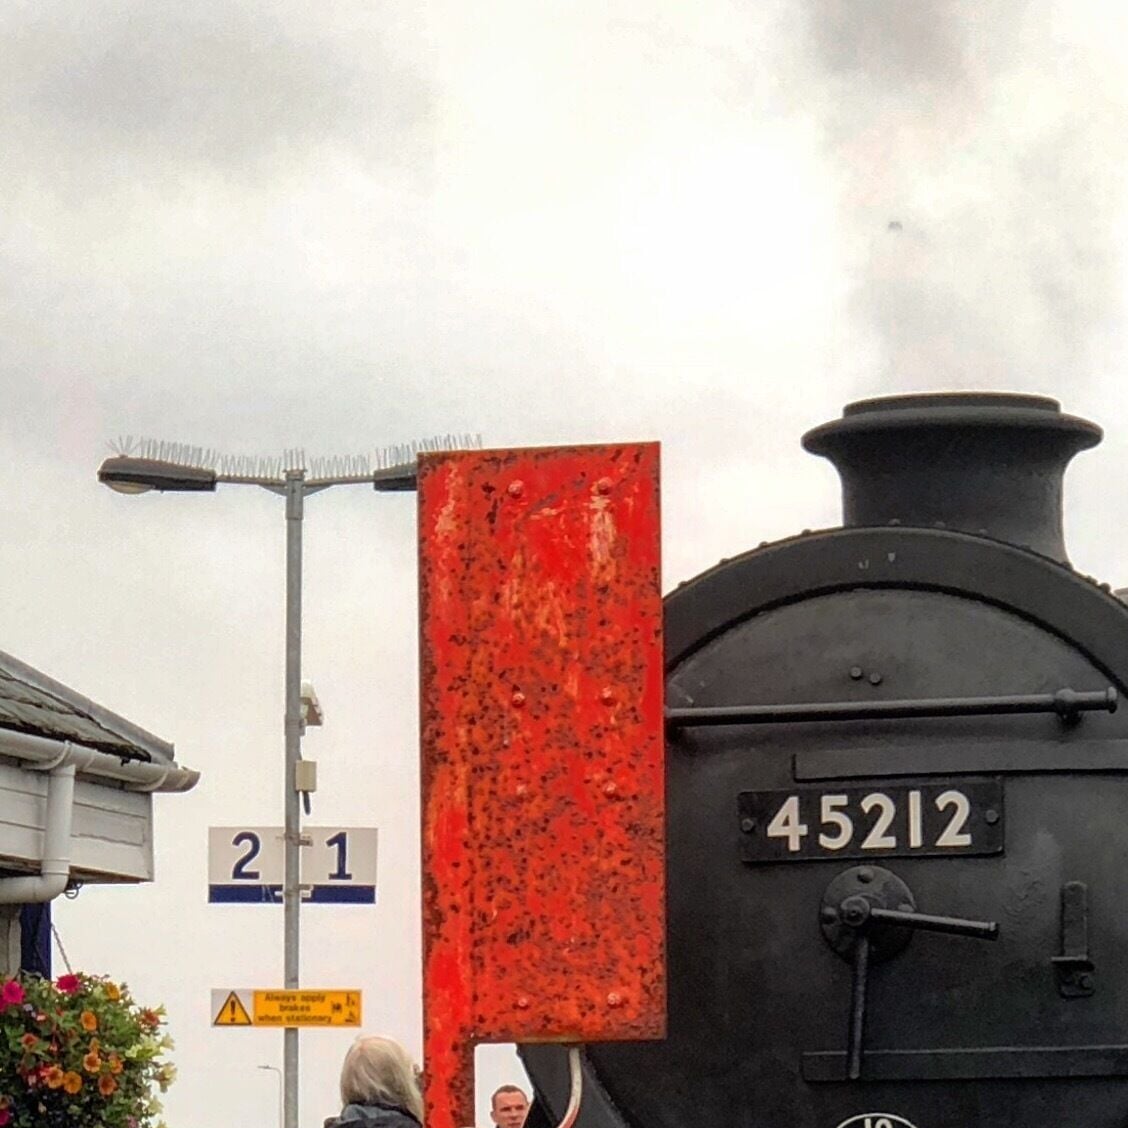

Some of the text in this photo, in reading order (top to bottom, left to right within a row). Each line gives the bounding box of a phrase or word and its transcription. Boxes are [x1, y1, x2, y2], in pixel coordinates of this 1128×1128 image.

[766, 790, 972, 851] 45212
[232, 831, 261, 880] 2
[326, 831, 352, 880] 1
[265, 991, 326, 1003] Always apply
[279, 1003, 311, 1012] brakes
[258, 1014, 332, 1024] when stationary
